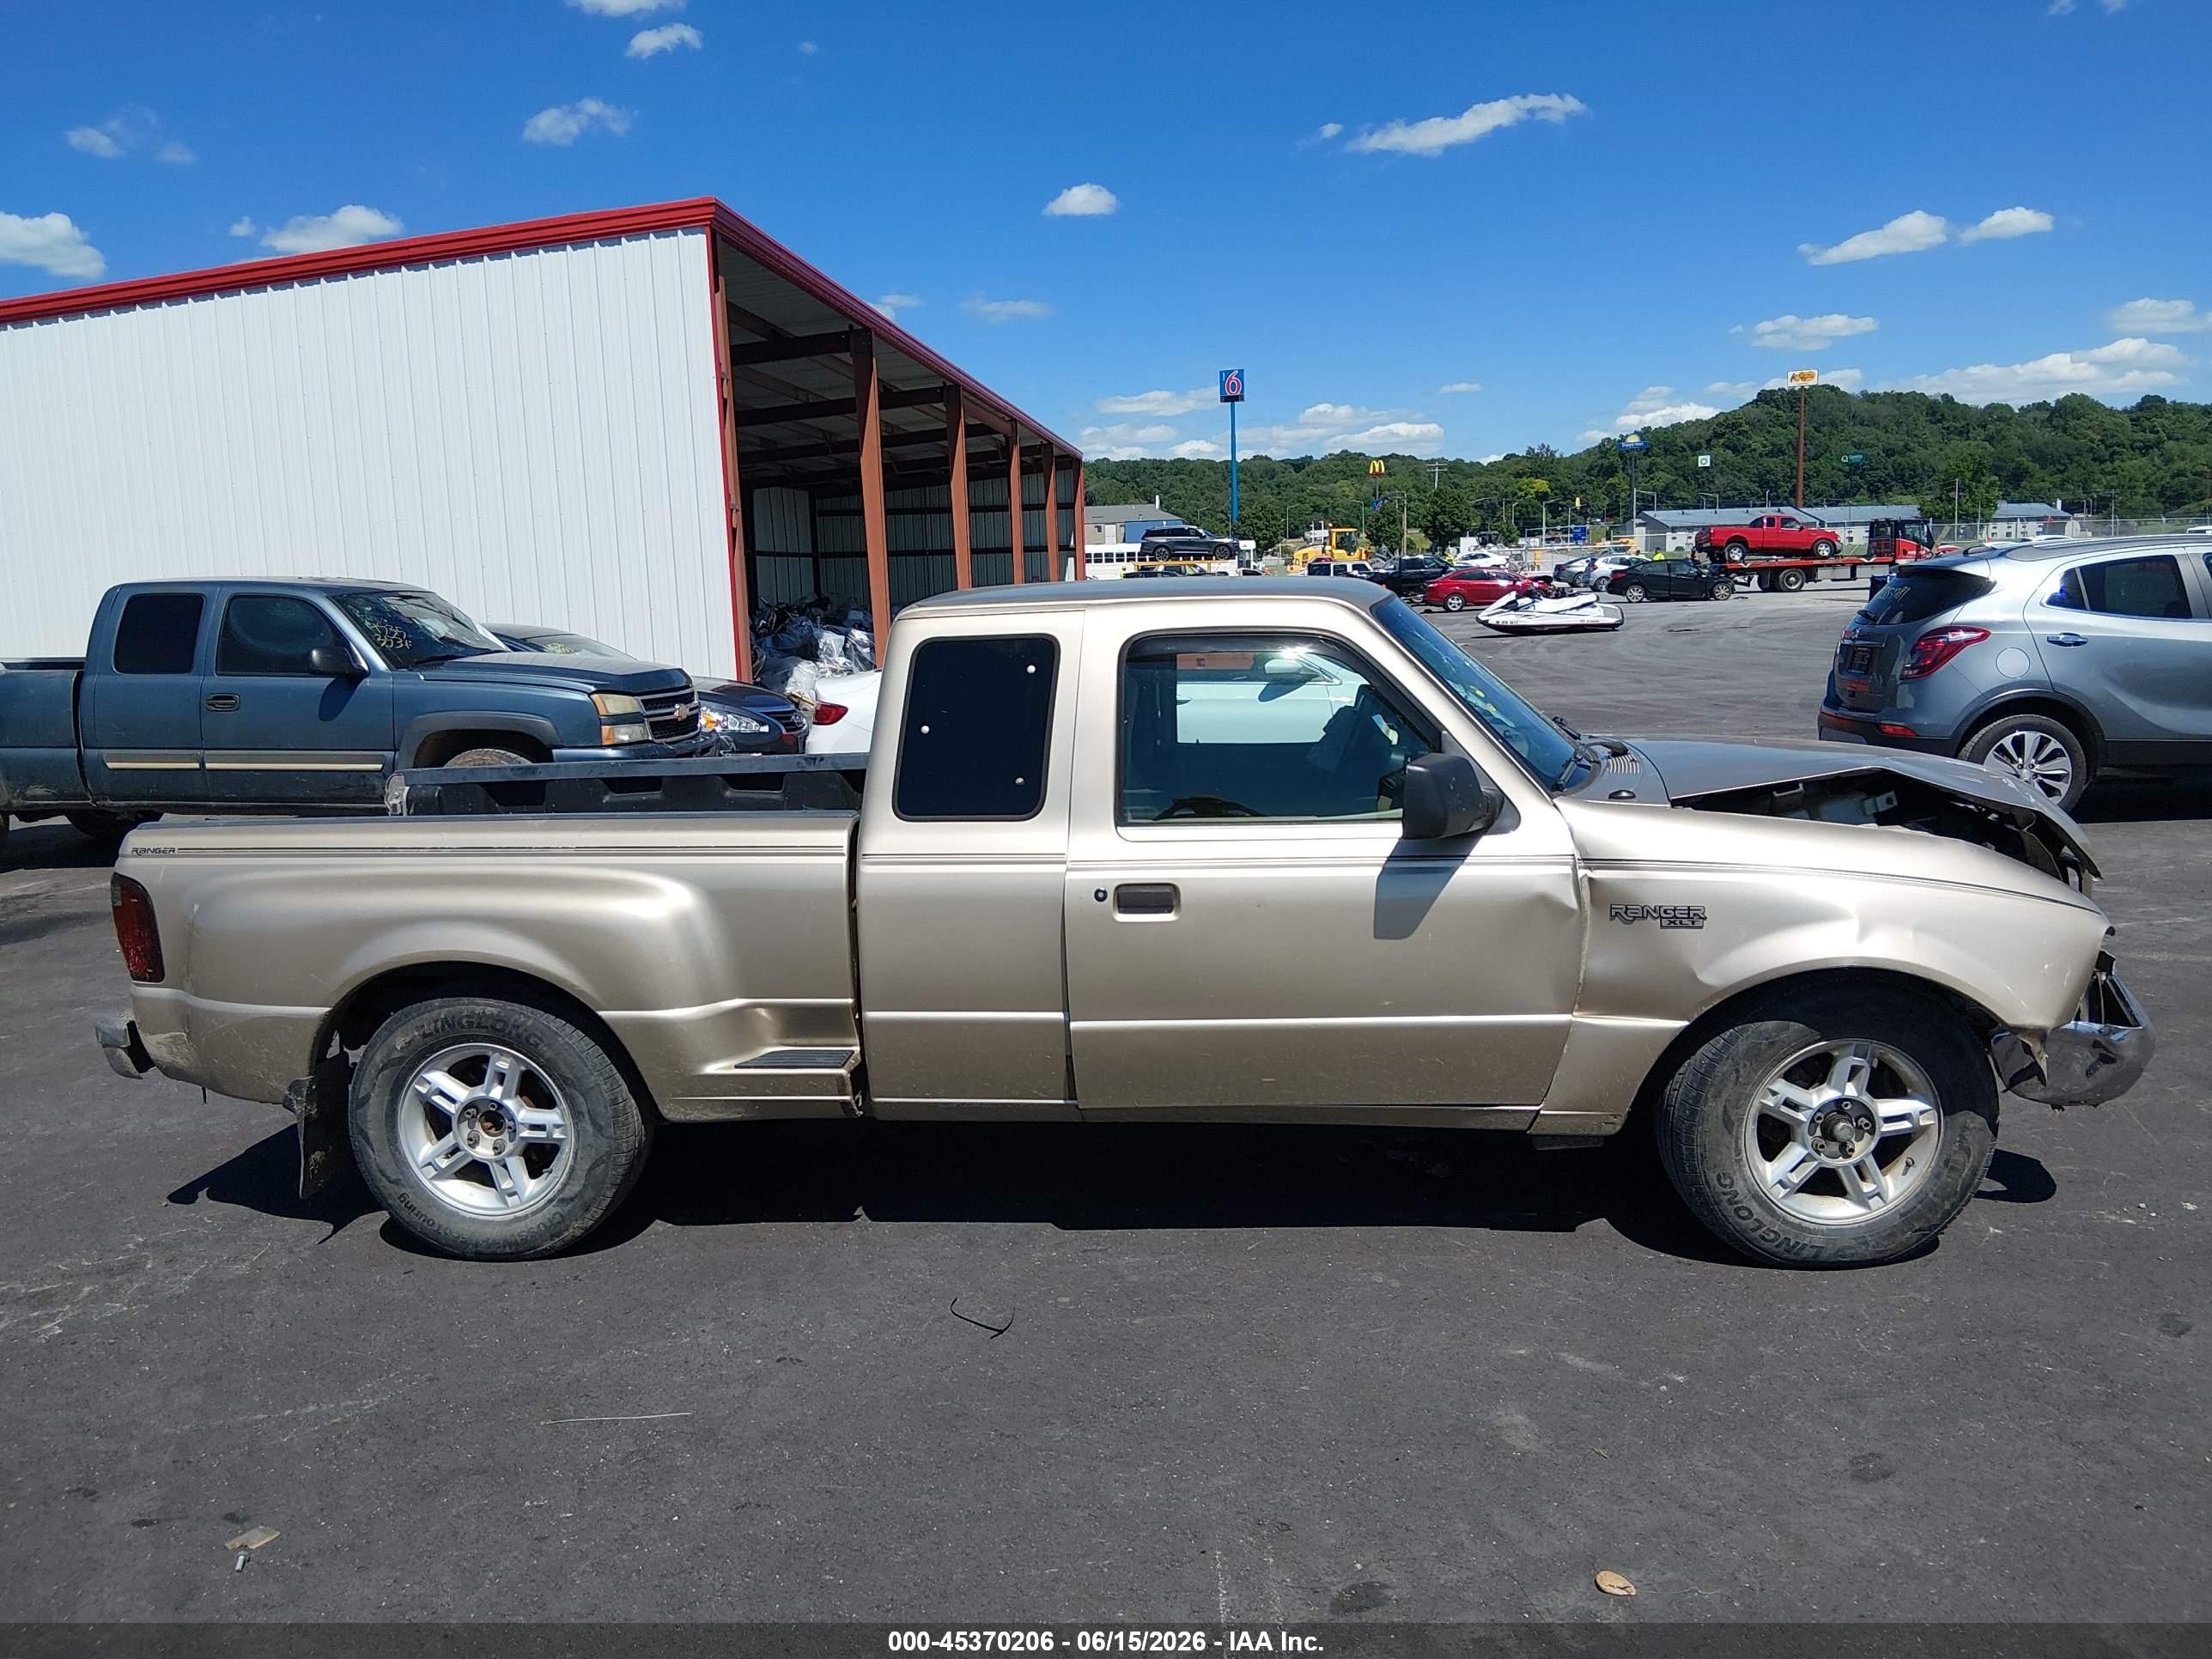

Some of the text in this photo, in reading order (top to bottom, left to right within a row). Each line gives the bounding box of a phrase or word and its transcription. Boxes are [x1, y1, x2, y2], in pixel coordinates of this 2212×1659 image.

[1225, 370, 1243, 396] 6
[131, 847, 176, 857] RANGER
[1610, 904, 1707, 924] RANGER
[1717, 1172, 1825, 1260] LINGLONG
